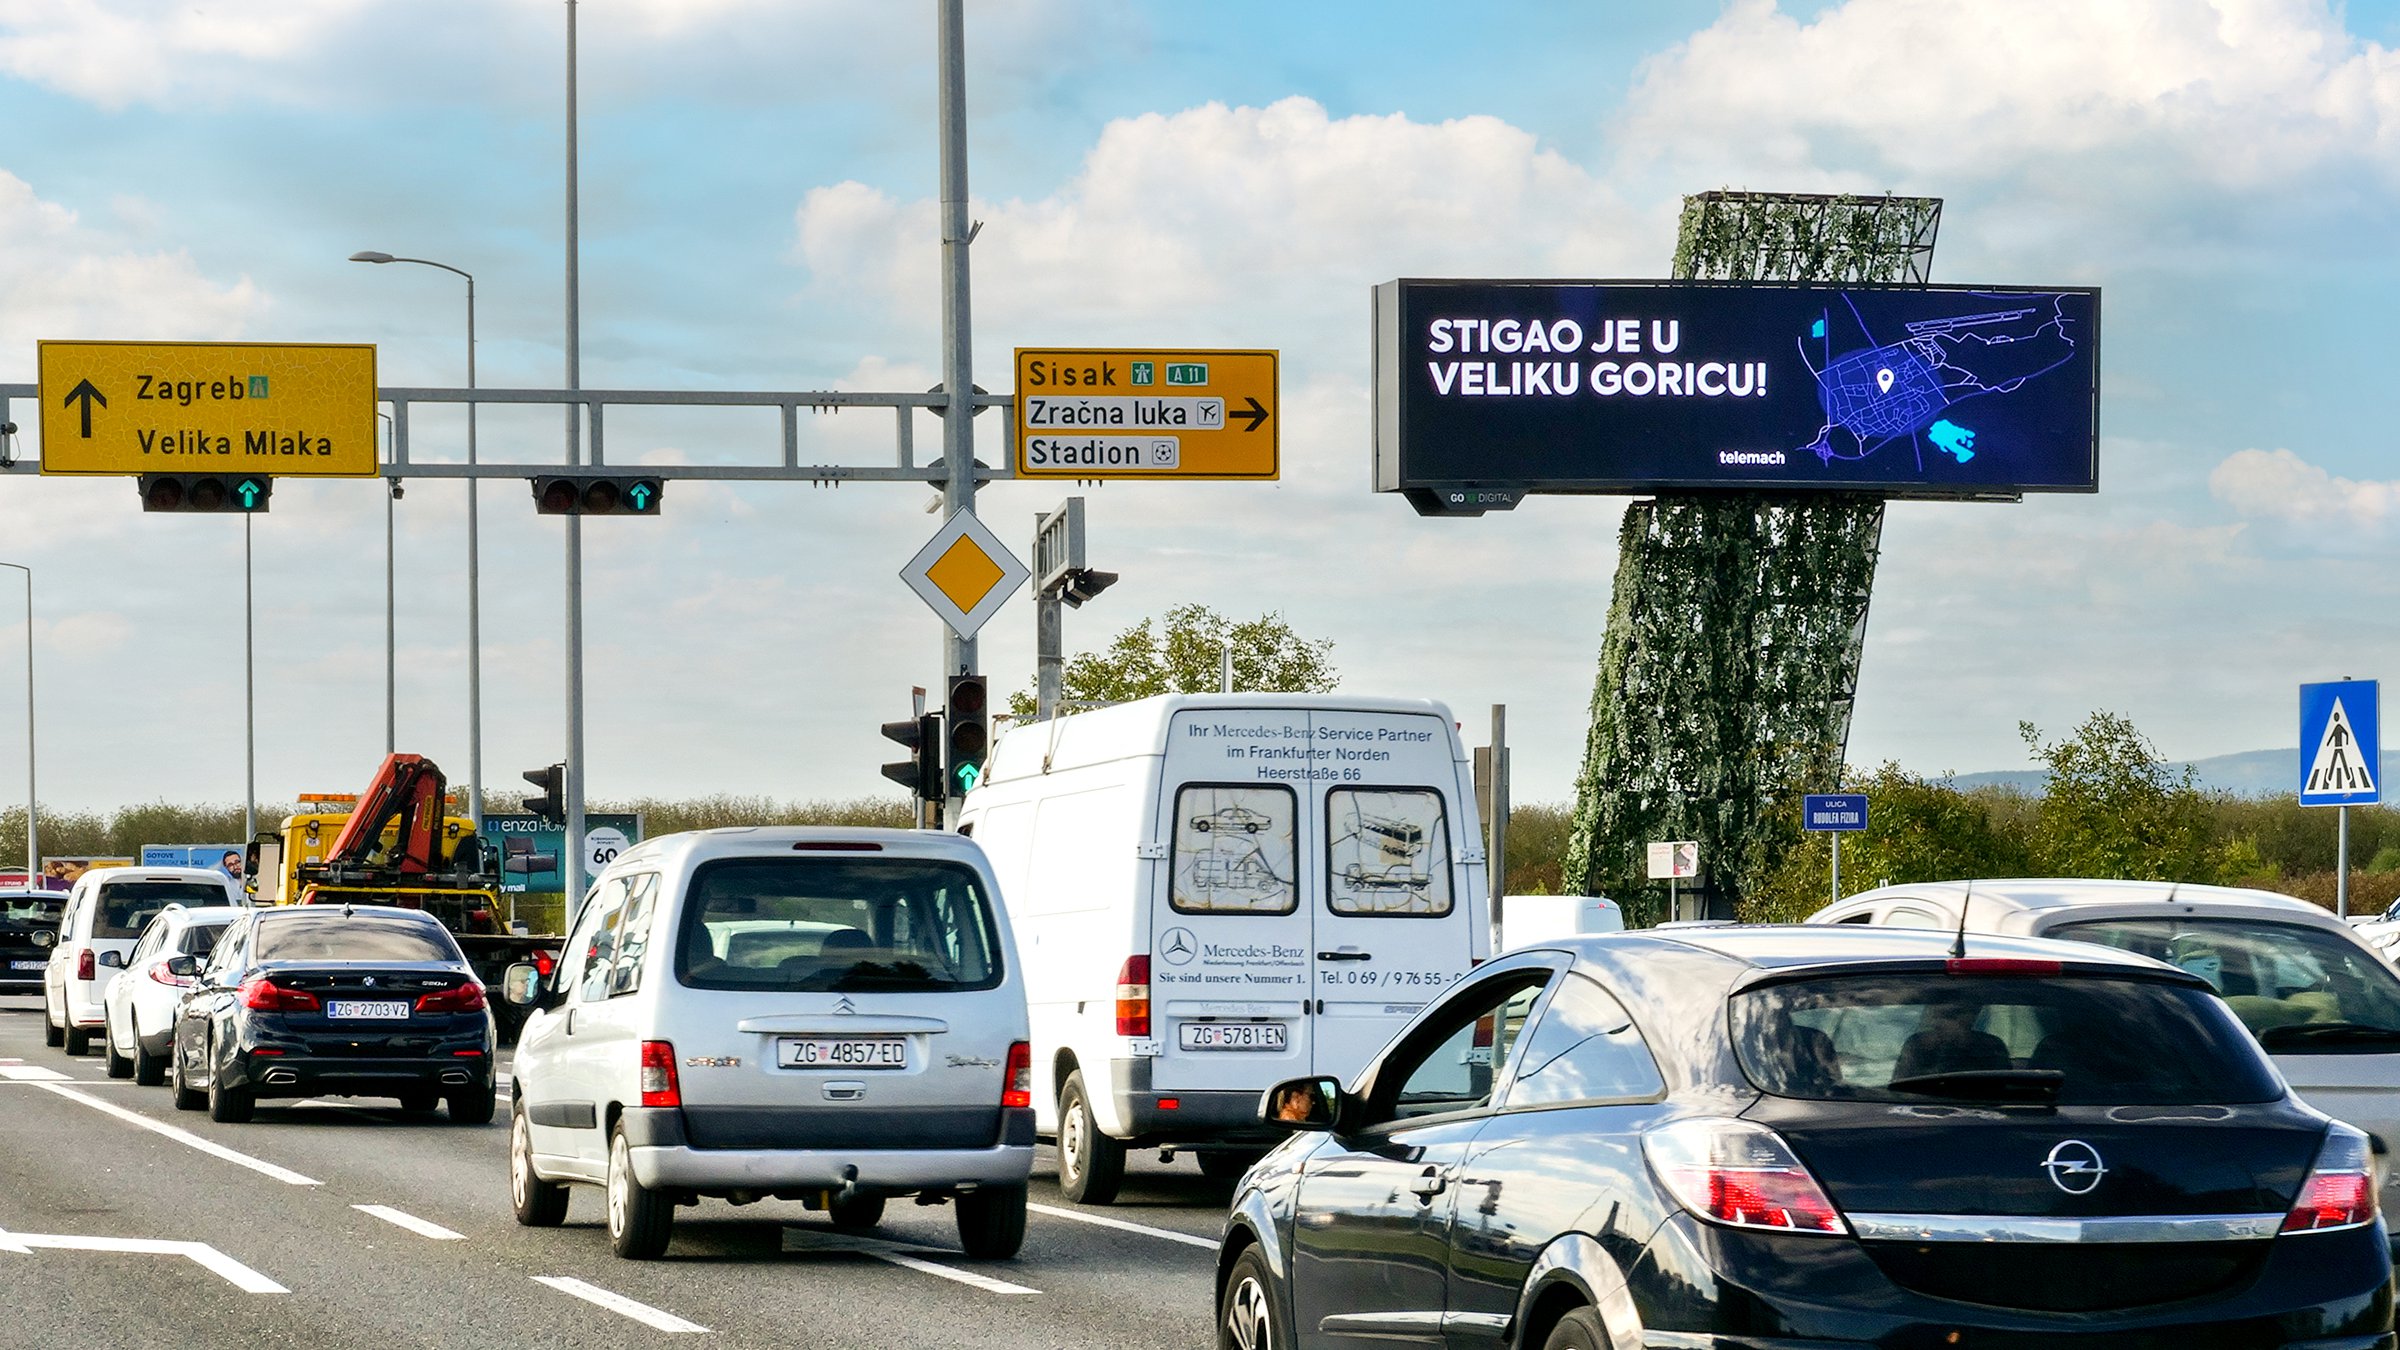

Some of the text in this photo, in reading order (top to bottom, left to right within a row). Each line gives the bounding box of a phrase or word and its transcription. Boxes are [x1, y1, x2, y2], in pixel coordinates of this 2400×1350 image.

[1428, 319, 1679, 353] STIGAO JE U
[1029, 361, 1117, 386] Sisak
[1174, 367, 1199, 382] A 11
[1428, 362, 1768, 397] VELIKU GORICU!
[137, 375, 245, 406] Zagreb
[1030, 400, 1186, 425] Zračna luka
[137, 429, 331, 456] Velika Mlaka
[1031, 439, 1140, 465] Stadion
[1719, 450, 1786, 465] telemach
[1450, 493, 1513, 503] GO DIGITAL
[1189, 724, 1432, 742] Ihr Mercedes-Benz Service Partner
[1227, 745, 1390, 761] im Frankfurter Norden
[1257, 766, 1361, 781] Heerstraße 66
[501, 820, 537, 832] enza
[507, 884, 526, 892] mall
[1204, 944, 1304, 958] Mercedes-Benz
[1159, 973, 1306, 984] Sie sind unsere Nummer 1.
[1320, 971, 1343, 984] Tel.
[1424, 973, 1441, 985] 55
[337, 1004, 352, 1016] ZG
[1193, 1028, 1212, 1043] ZG
[794, 1043, 816, 1063] ZG
